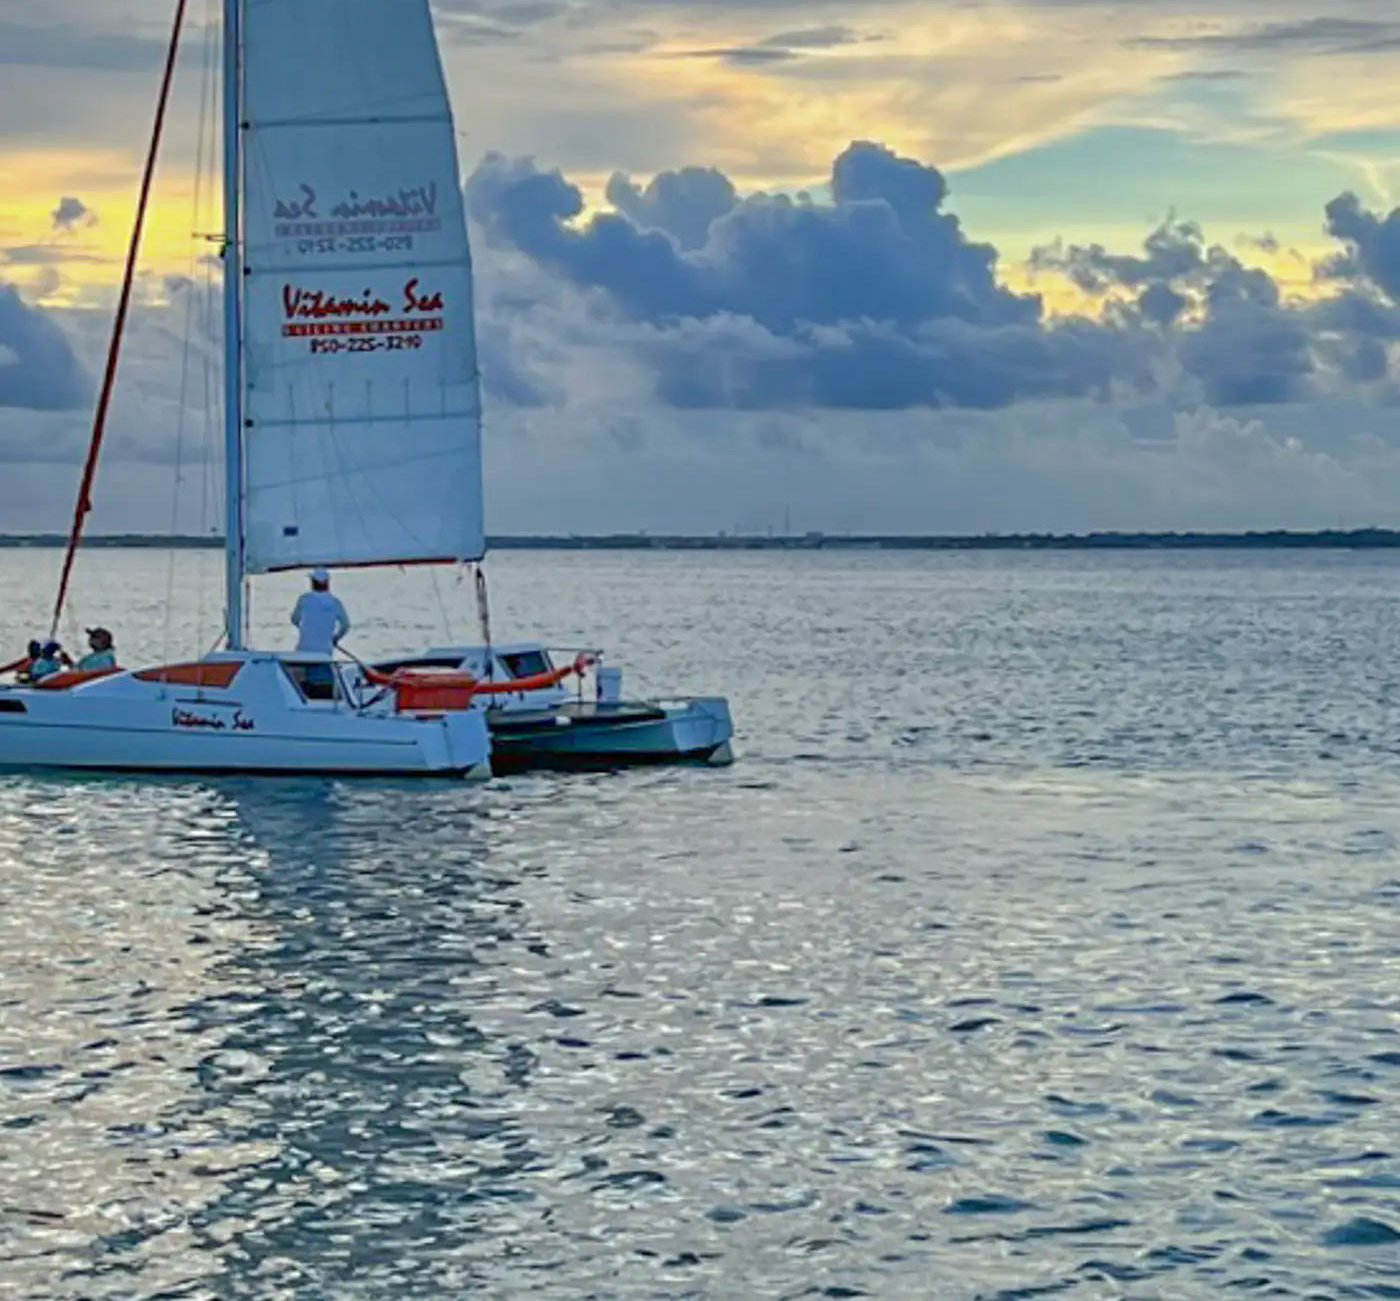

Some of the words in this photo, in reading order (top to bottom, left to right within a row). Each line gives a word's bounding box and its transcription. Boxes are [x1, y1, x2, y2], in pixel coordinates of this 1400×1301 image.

[283, 283, 392, 318] Vitamin
[402, 277, 444, 312] Sea
[172, 706, 226, 730] Vitamin
[232, 708, 254, 730] Sea
